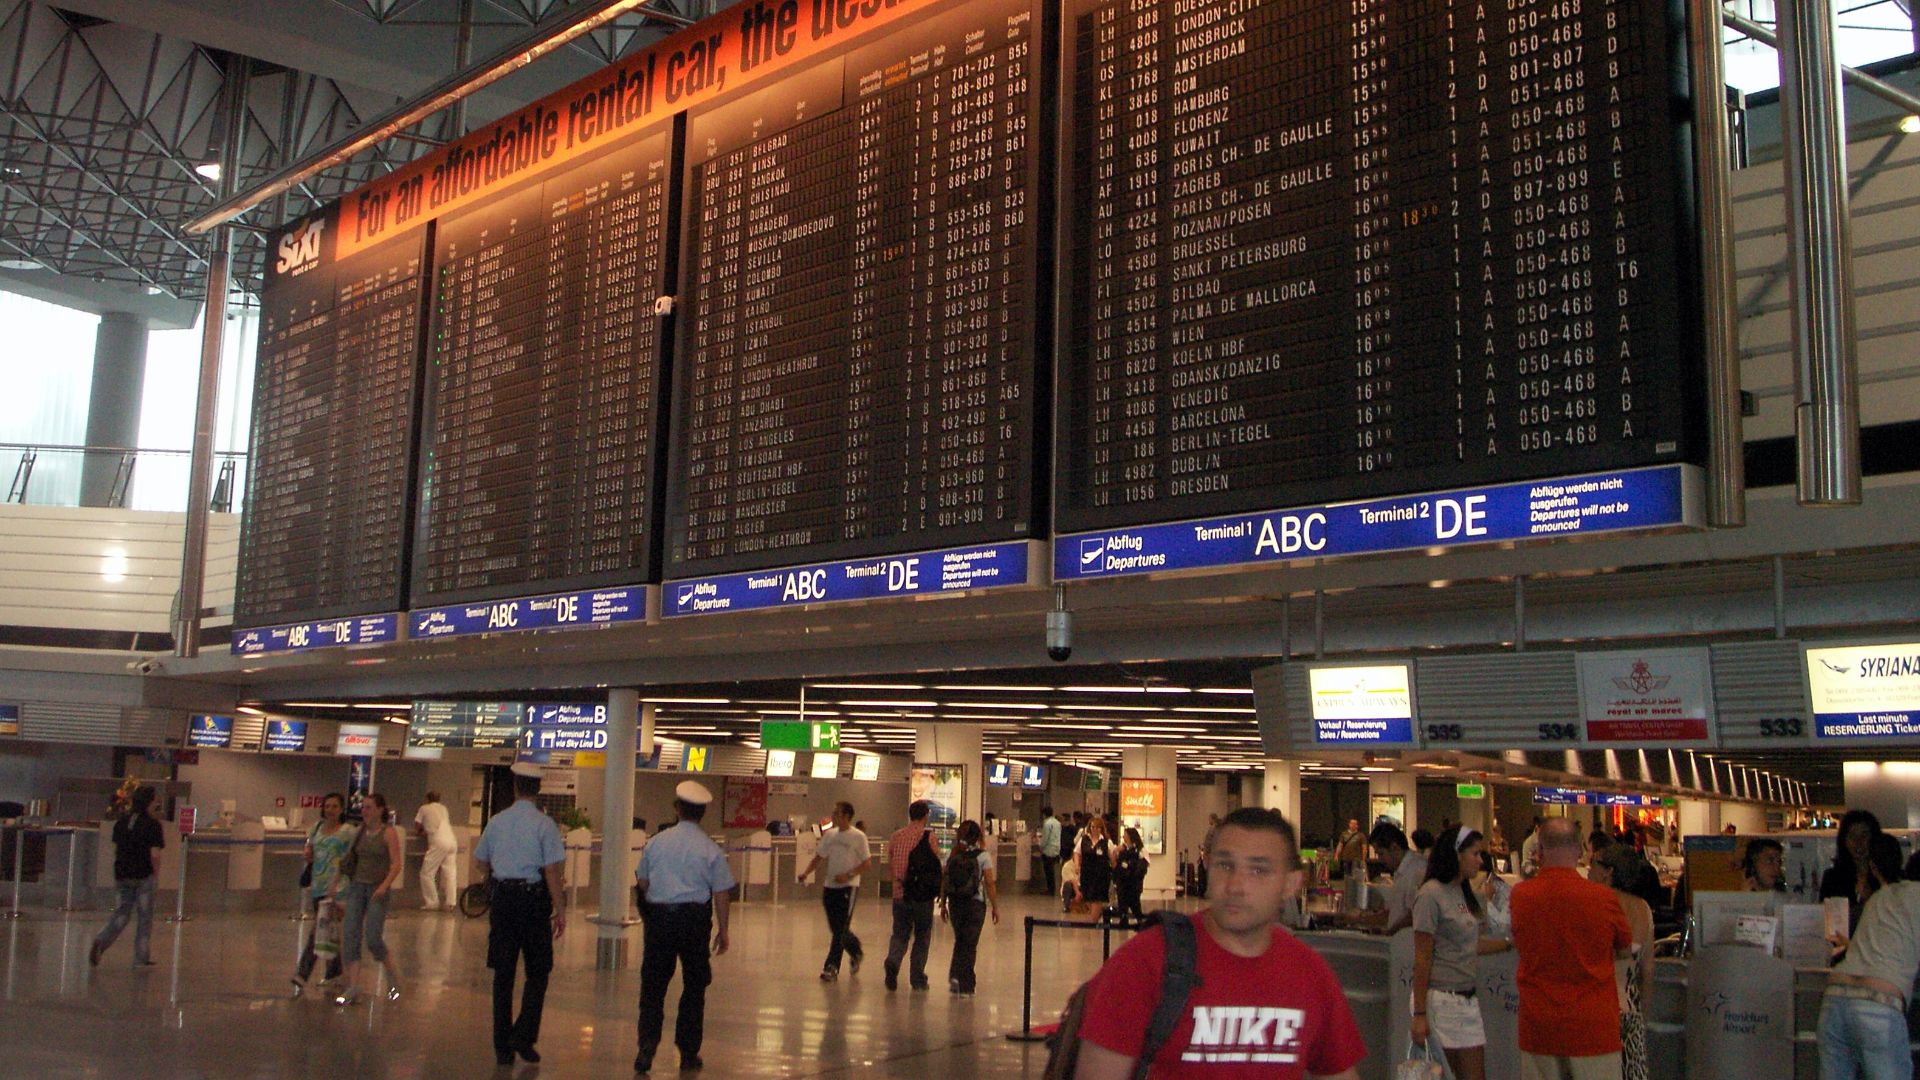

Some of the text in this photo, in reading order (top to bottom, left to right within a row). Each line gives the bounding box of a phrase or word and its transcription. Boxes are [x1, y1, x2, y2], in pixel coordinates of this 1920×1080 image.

[1130, 30, 1158, 51] 4808
[1508, 1, 1581, 34] 050-468
[1137, 19, 1245, 70] 284 INNSBRUCK
[952, 55, 995, 81] 701-702
[1008, 42, 1027, 61] B55
[1130, 39, 1583, 91] 1768 AMSTERDAM 801-807
[952, 74, 994, 99] 808-809
[1174, 76, 1197, 96] ROM
[951, 91, 994, 116] 481-489
[1174, 86, 1229, 116] HAMBURG
[356, 188, 390, 242] For
[396, 173, 422, 224] an
[430, 106, 558, 209] affordable
[567, 53, 655, 150] rental
[666, 32, 725, 105] car,
[740, 0, 798, 72] the
[1129, 108, 1229, 150] 4008 FLORENZ
[1174, 130, 1221, 157] KUWAIT
[1255, 135, 1270, 155] DE
[1280, 118, 1332, 148] GAULLE
[950, 146, 992, 171] 759-784
[1174, 168, 1588, 202] ZAGREB 897-899
[1174, 197, 1212, 219] PARIS
[1255, 178, 1270, 197] DE
[1280, 162, 1333, 190] GAULLE
[1174, 201, 1272, 239] POZNAN/POSEN
[1173, 235, 1236, 261] BRUESSEL
[1173, 237, 1307, 282] SANKT PETERSBURG
[1173, 279, 1220, 302] BILBAO
[1173, 260, 1638, 323] PALMA DE MALLORCA T6
[1173, 325, 1204, 345] WIEN
[1173, 338, 1245, 366] KOELN HBF
[1172, 354, 1280, 388] GDANSK/DANZIG
[1173, 385, 1229, 409] VENEDIG
[1172, 404, 1245, 431] BARCELONA
[1172, 423, 1271, 453] BERLIN-TEGEL
[1171, 474, 1229, 496] DRESDEN
[1530, 478, 1623, 498] Abflüge werden nicht
[1530, 496, 1578, 510] ausgerufen
[1531, 502, 1629, 522] Departures will not be
[1360, 495, 1487, 539] Terminal 2 DE
[1531, 519, 1580, 533] announced
[1107, 535, 1142, 551] Abflug
[1196, 512, 1326, 555] Terminal 1 ABC
[845, 559, 919, 591] Terminal 2 DE
[1107, 553, 1165, 572] Departures
[694, 583, 716, 596] Abflug
[748, 569, 826, 601] Terminal 1 ABC
[489, 602, 518, 628] ABC
[558, 596, 578, 622] DE
[694, 598, 730, 612] Departures
[288, 625, 310, 647] ABC
[336, 621, 351, 643] DE
[557, 714, 593, 724] Departures
[558, 705, 606, 724] Abflug B
[1347, 720, 1386, 730] Reservierung
[1760, 718, 1802, 736] 533
[1858, 714, 1908, 724] Last minute
[557, 730, 607, 748] Terminal 2 D
[1320, 731, 1379, 739] Sales Reservations
[1824, 724, 1892, 735] RESERVIERUNG
[556, 740, 594, 749] via Sky Line
